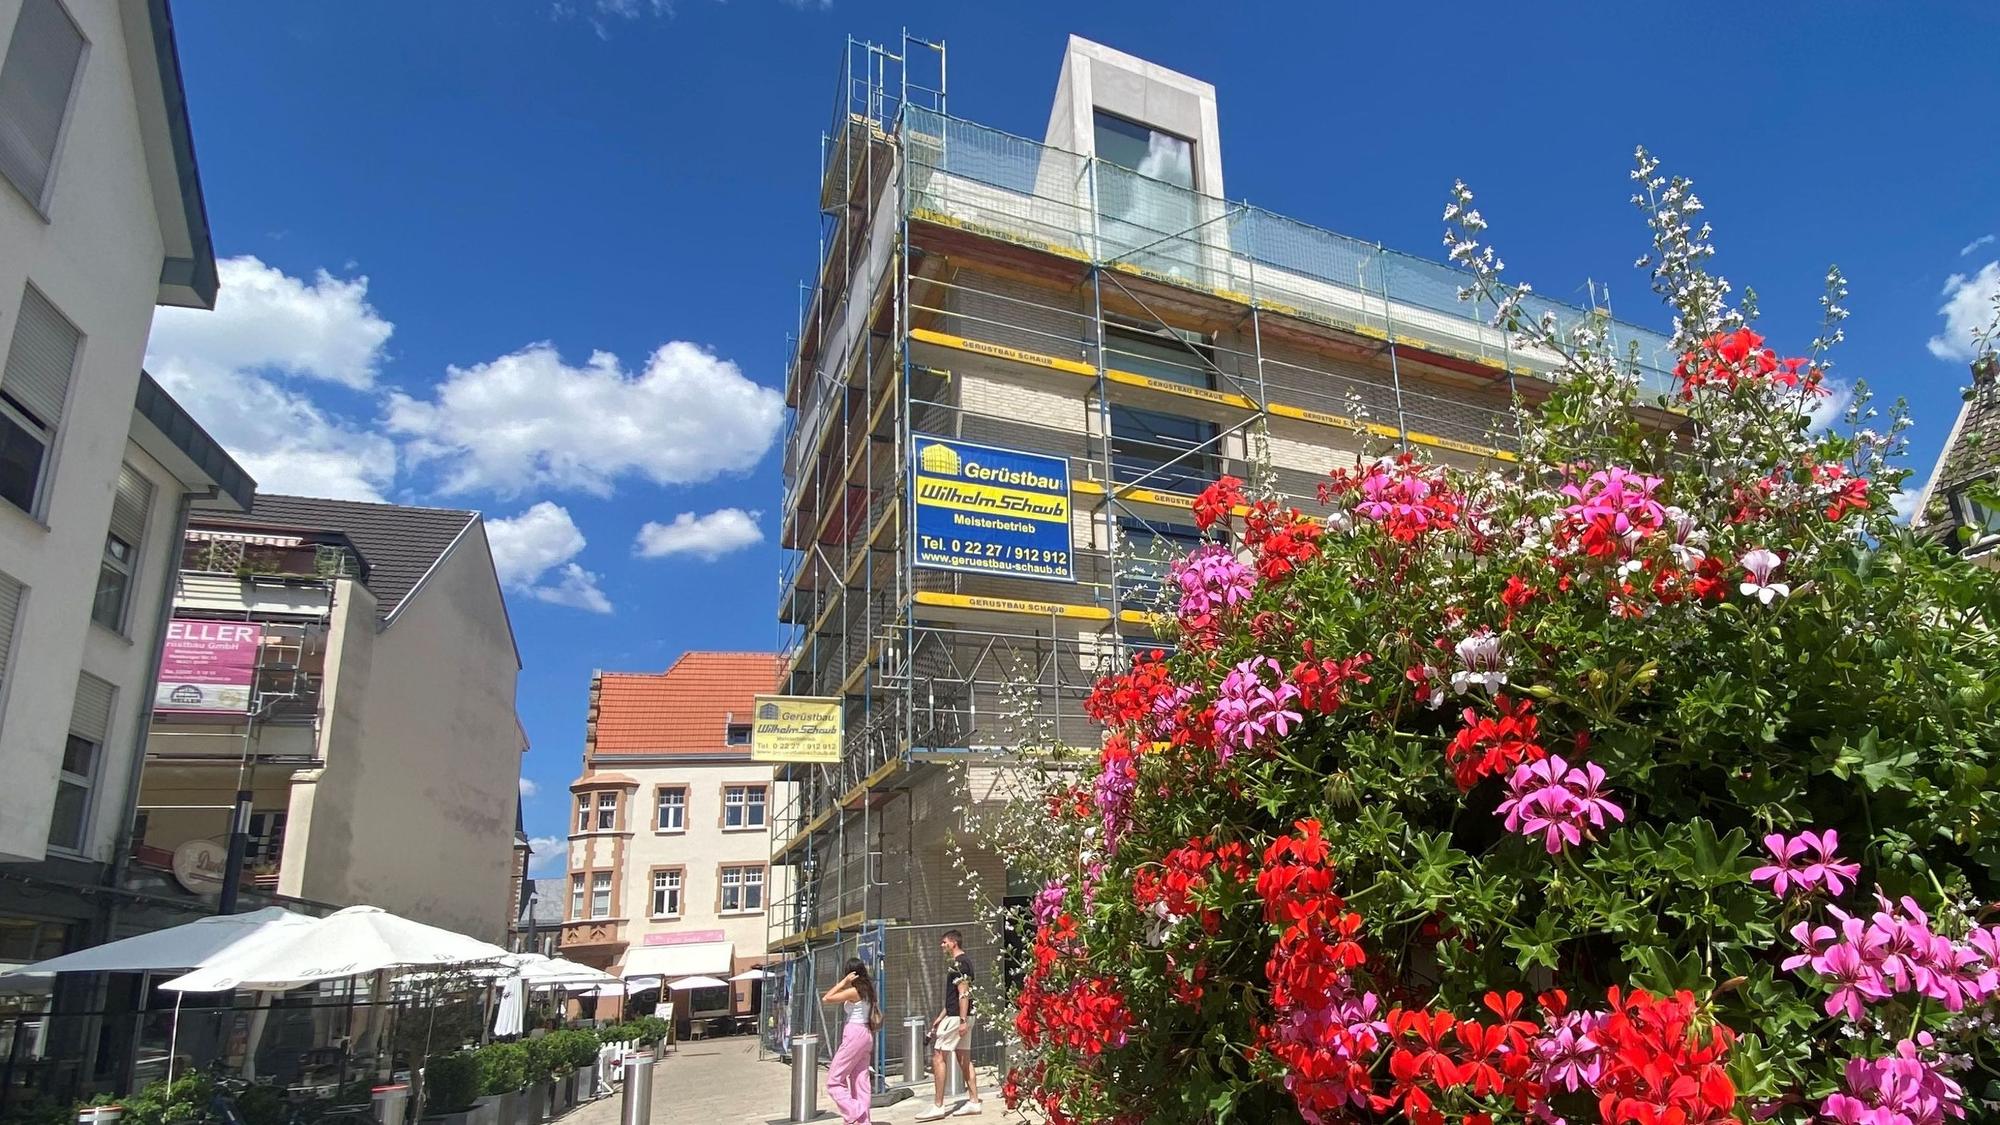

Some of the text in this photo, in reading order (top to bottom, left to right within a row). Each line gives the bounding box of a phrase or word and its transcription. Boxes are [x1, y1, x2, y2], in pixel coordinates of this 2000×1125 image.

[1018, 353, 1053, 365] SCHAUB
[1194, 389, 1223, 401] SCHAUB
[964, 462, 1060, 490] Gerüstbau
[920, 484, 1064, 517] Wilhelm Schaub
[953, 513, 1036, 534] Meisterbetrieb
[921, 536, 946, 551] Tel.
[951, 539, 961, 552] 0
[964, 541, 982, 555] 22
[986, 544, 1003, 557] 27
[1015, 547, 1040, 562] 912
[1043, 550, 1067, 565] 912
[921, 552, 1068, 576] www.geruestbau-schaub.de
[1028, 604, 1065, 614] SCHAUB
[207, 642, 239, 651] GmbH
[782, 711, 835, 722] Gerüstbau
[757, 724, 799, 734] Wilhelm
